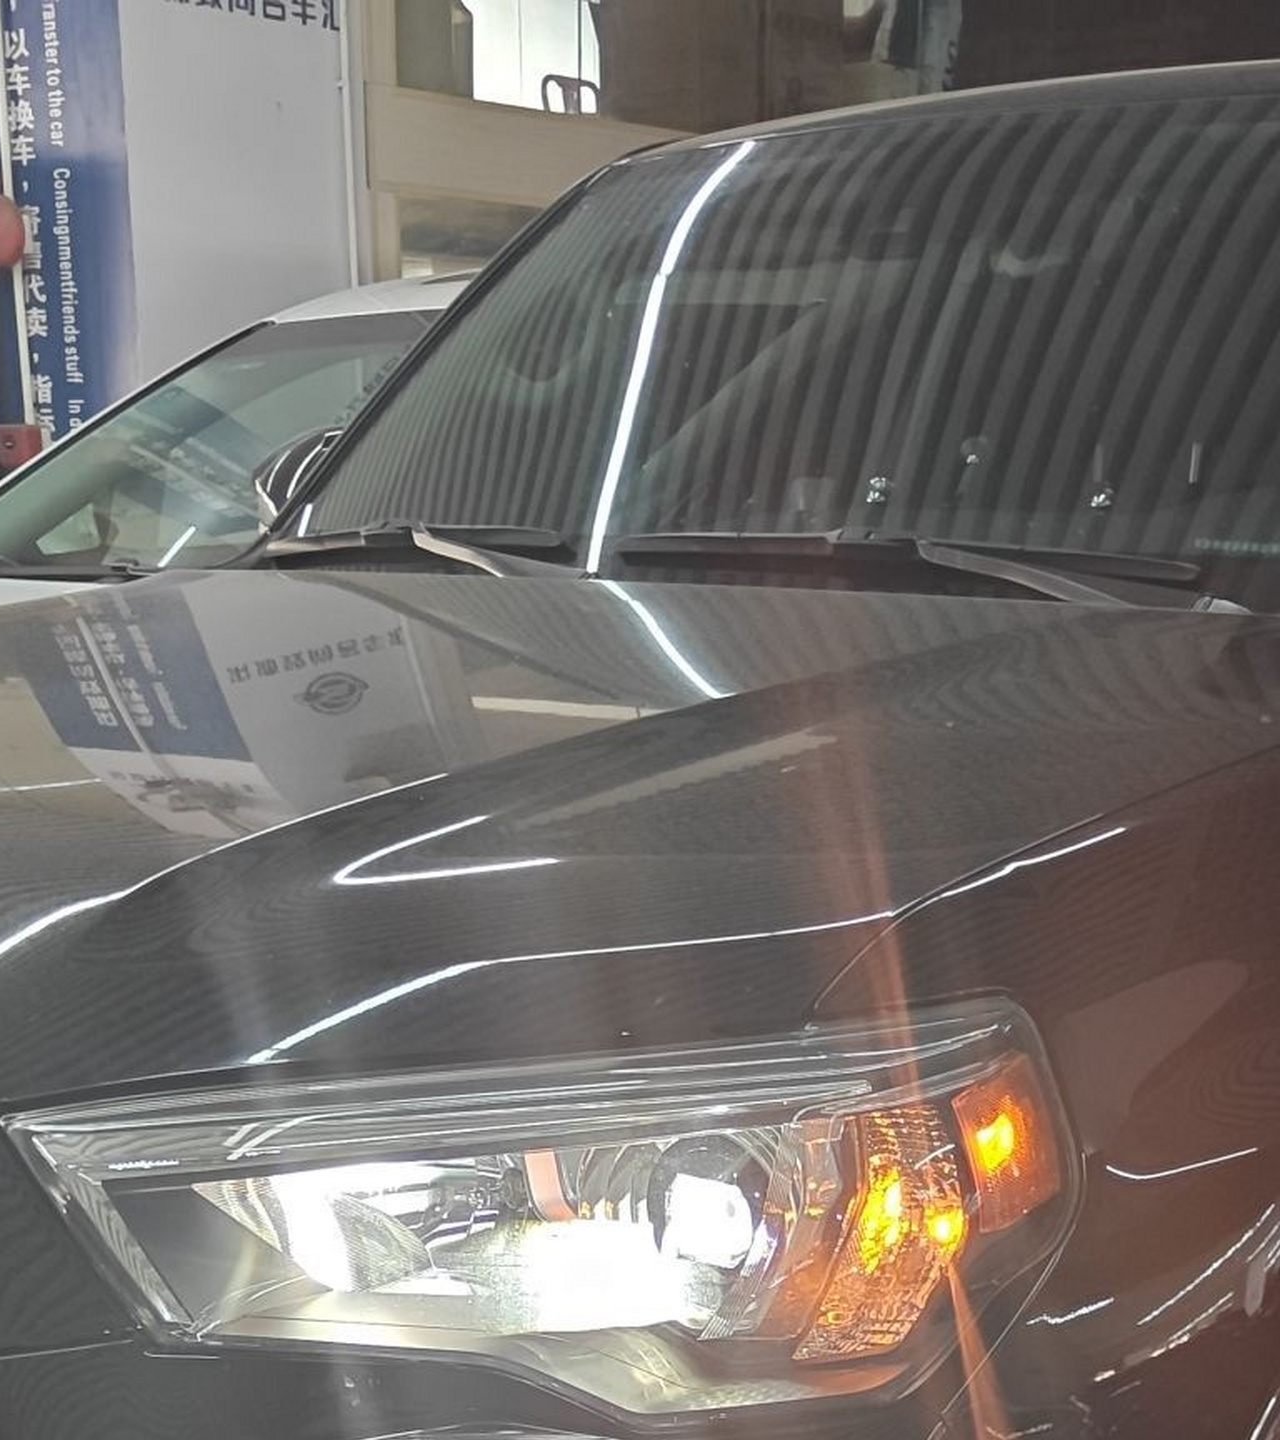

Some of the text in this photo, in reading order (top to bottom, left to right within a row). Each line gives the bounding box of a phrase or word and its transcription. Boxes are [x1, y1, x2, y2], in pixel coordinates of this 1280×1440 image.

[46, 67, 61, 87] to
[47, 88, 66, 118] the
[50, 121, 64, 147] car
[64, 346, 84, 384] stuff
